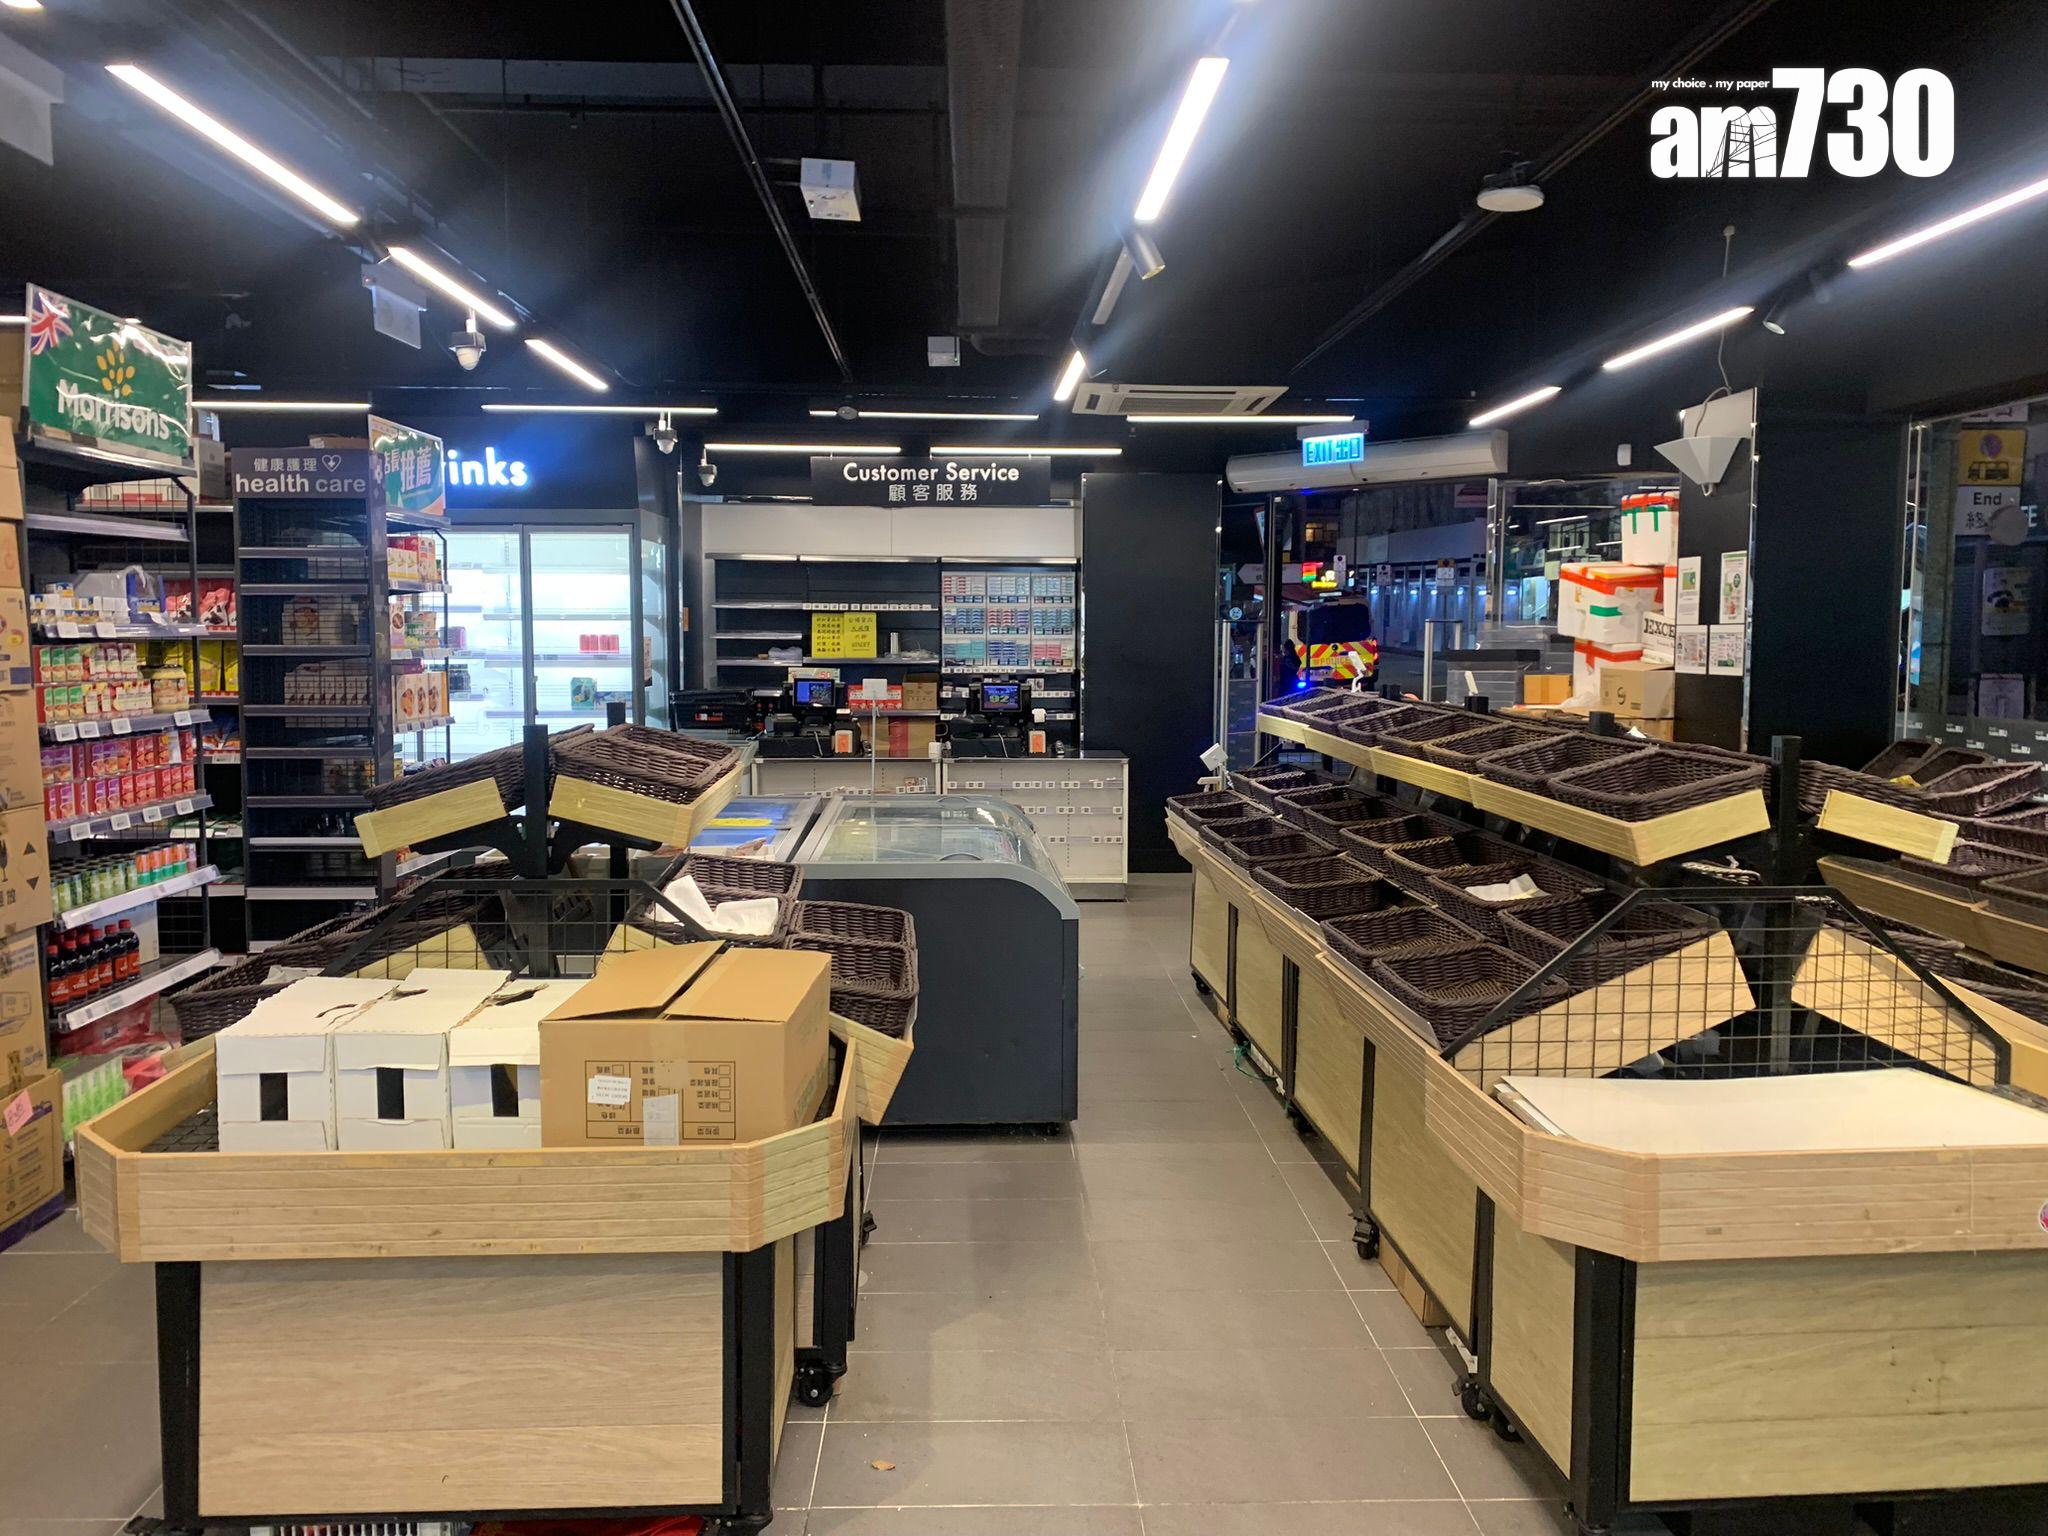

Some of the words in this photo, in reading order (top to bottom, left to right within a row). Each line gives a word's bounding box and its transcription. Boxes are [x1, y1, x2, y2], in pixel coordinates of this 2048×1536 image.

[57, 379, 170, 441] Morrisons
[1305, 440, 1333, 464] EXIT
[1335, 438, 1361, 460] 出口
[253, 457, 318, 473] 健康護理
[442, 447, 529, 487] inks
[843, 462, 939, 482] Customer
[945, 461, 1020, 482] Service
[235, 473, 310, 493] health
[315, 477, 366, 493] care
[888, 484, 978, 502] 顧客服務
[1973, 492, 2002, 506] End
